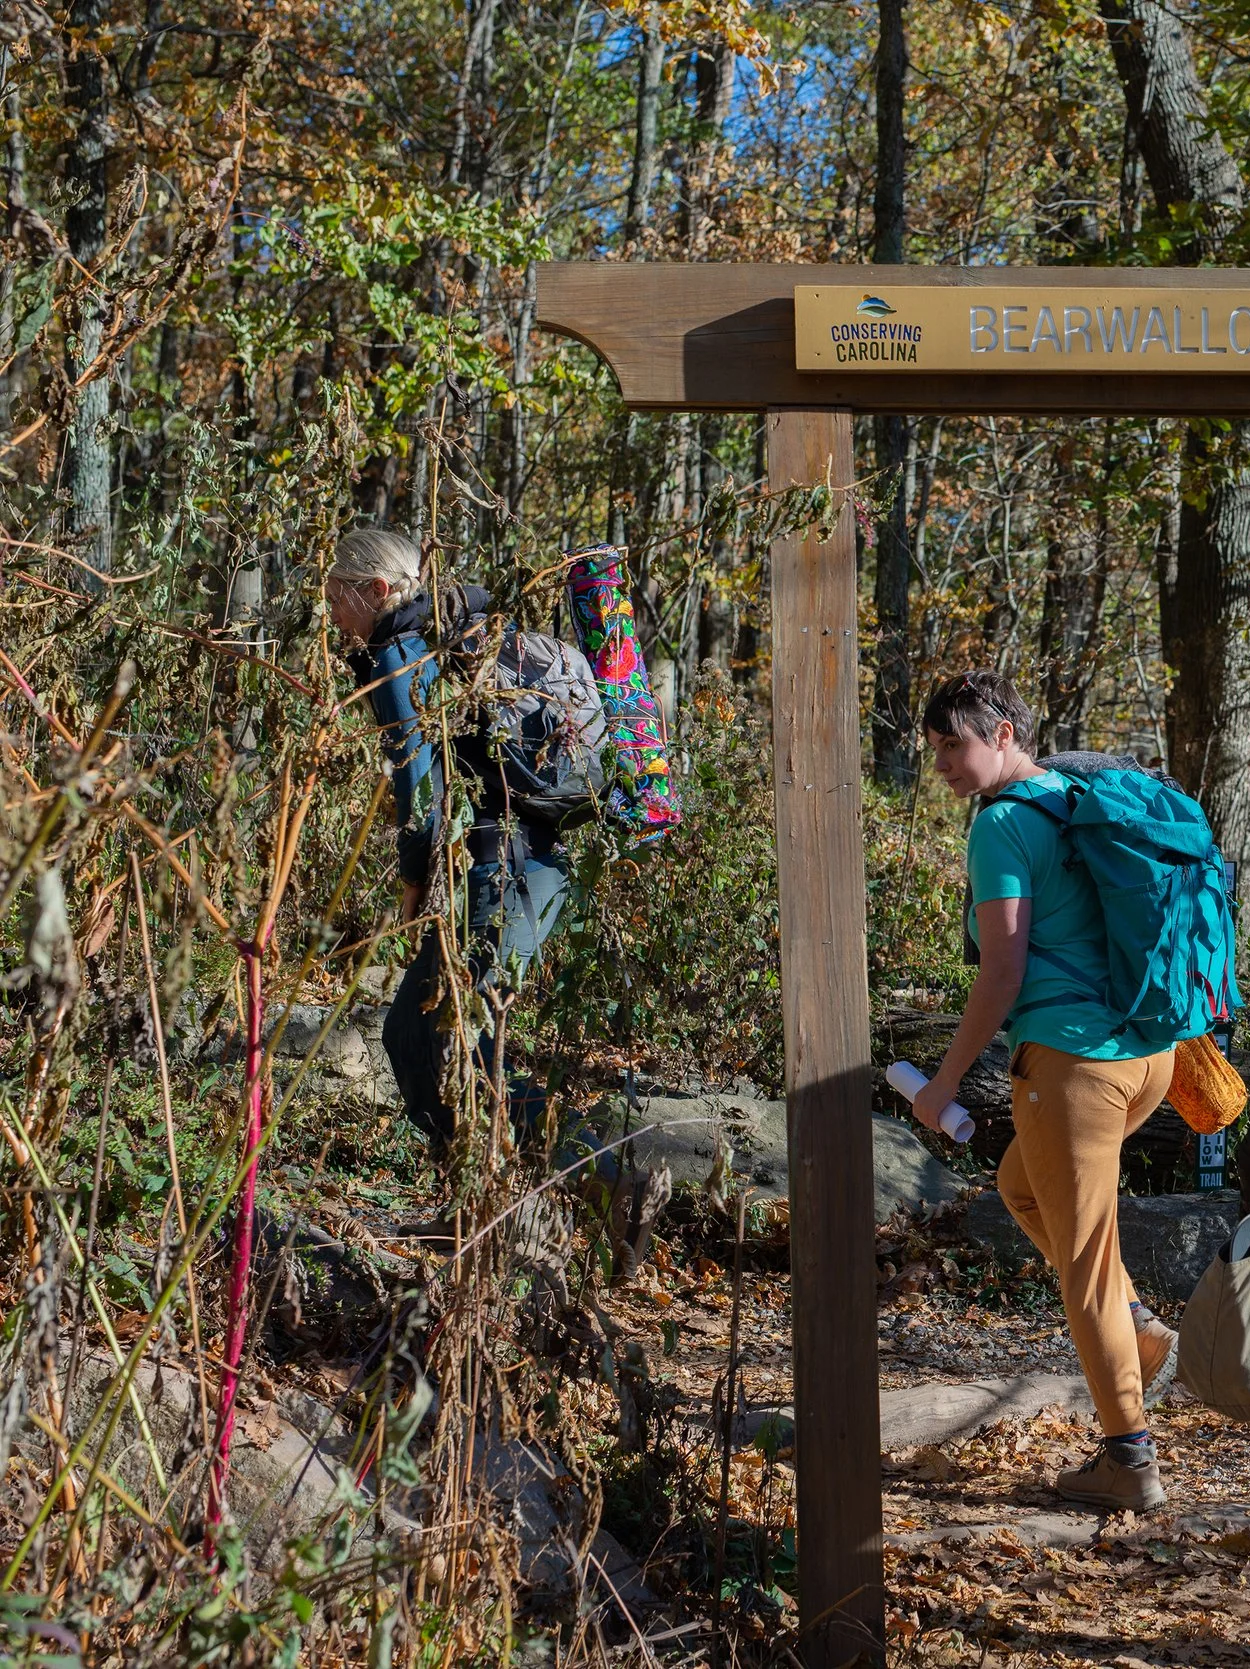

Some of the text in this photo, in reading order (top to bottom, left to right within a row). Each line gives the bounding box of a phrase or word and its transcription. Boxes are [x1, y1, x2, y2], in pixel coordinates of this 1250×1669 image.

[831, 322, 922, 342] CONSERVING
[836, 341, 917, 363] CAROLINA
[1200, 1173, 1223, 1187] TRAIL
